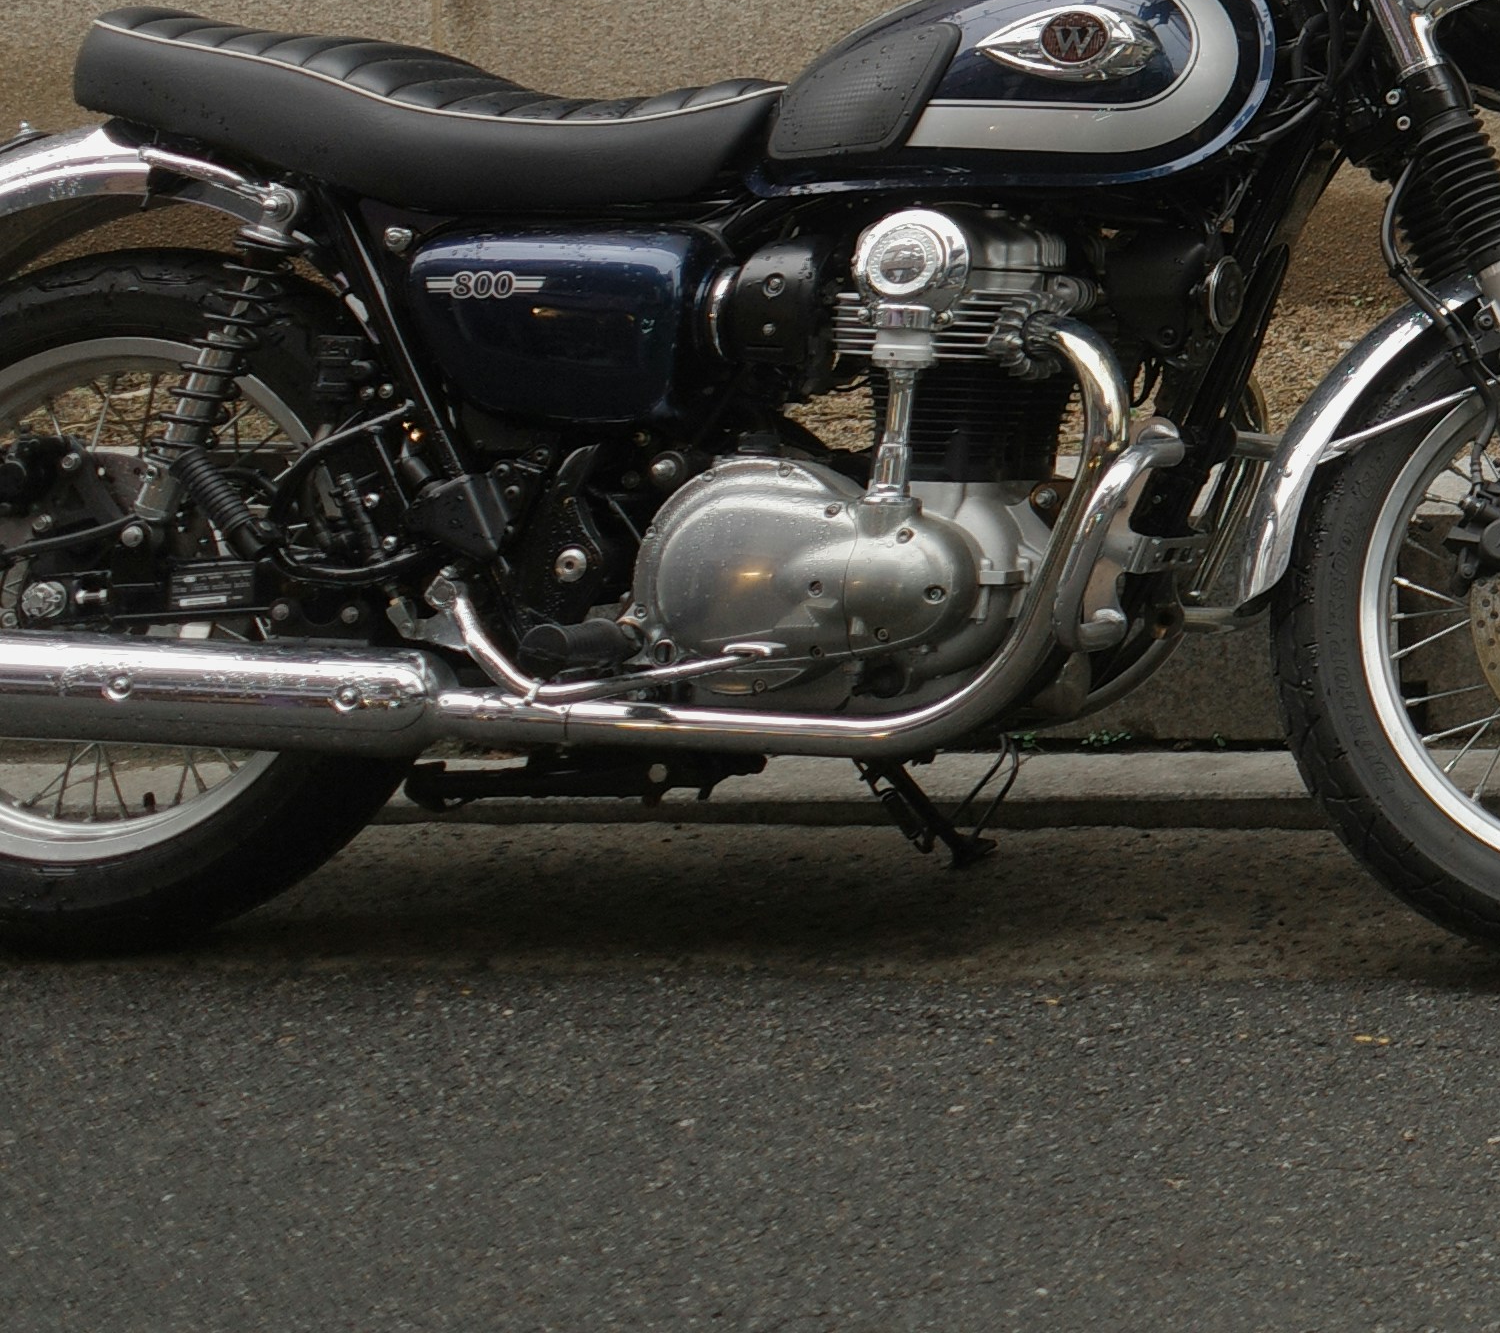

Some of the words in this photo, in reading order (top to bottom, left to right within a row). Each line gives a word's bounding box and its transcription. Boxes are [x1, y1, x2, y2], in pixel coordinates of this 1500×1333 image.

[1054, 25, 1099, 59] W
[451, 271, 514, 299] 800
[1328, 640, 1397, 786] DUNLOP
